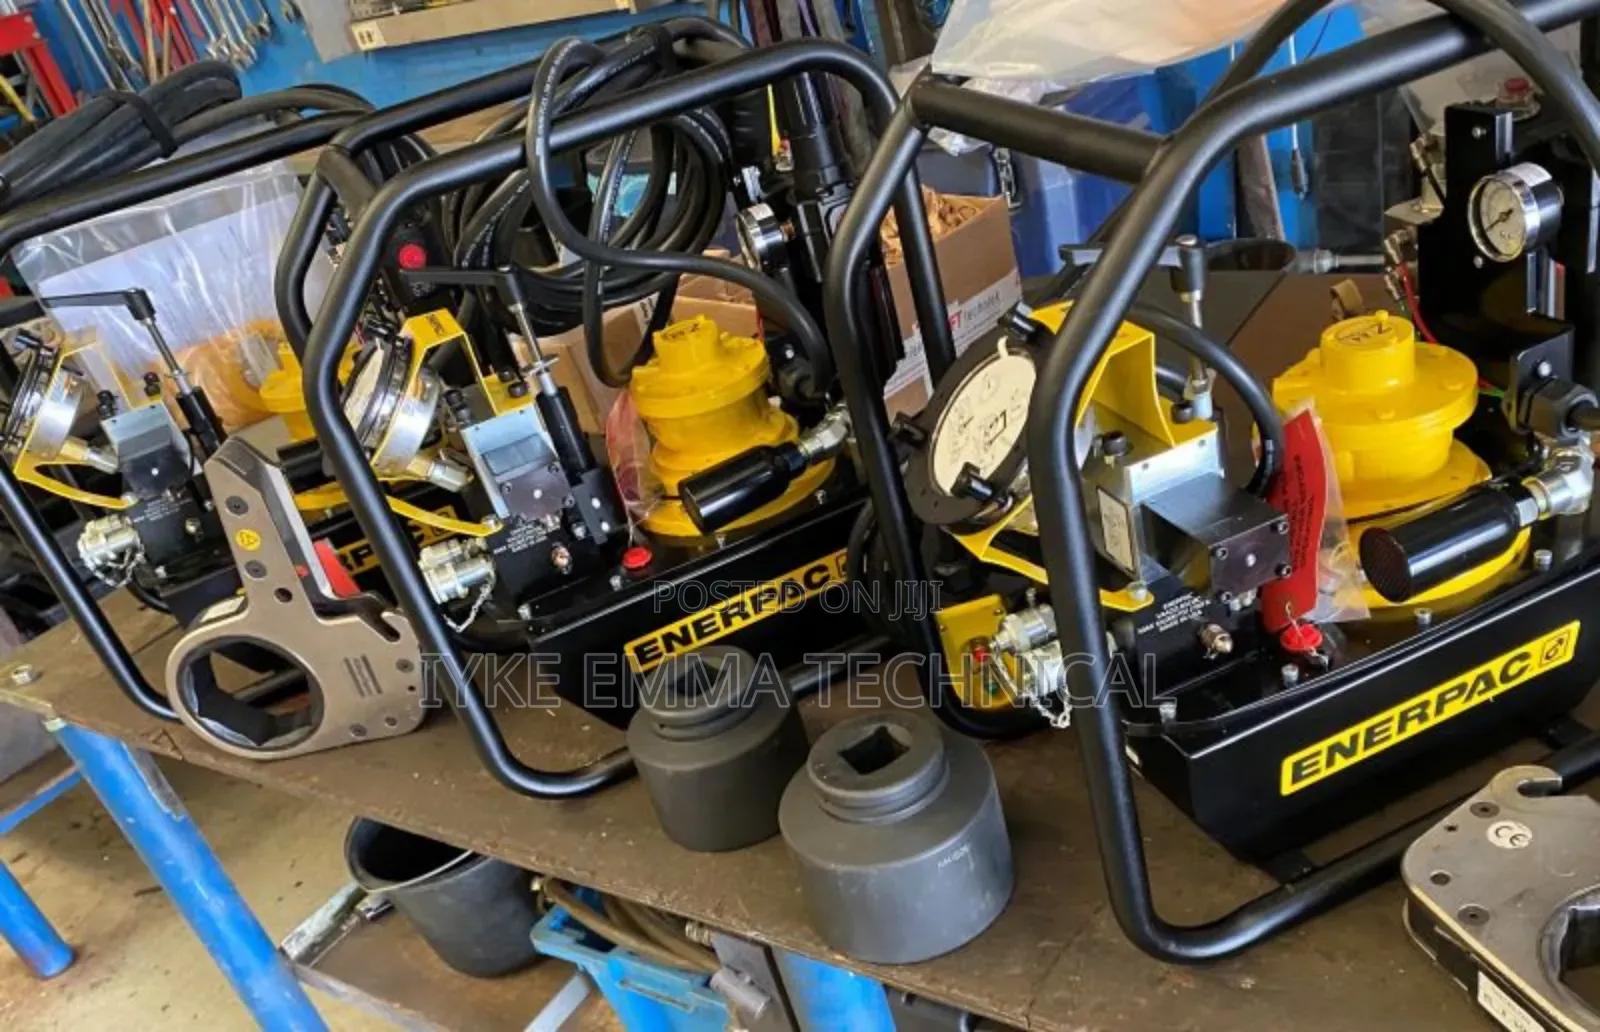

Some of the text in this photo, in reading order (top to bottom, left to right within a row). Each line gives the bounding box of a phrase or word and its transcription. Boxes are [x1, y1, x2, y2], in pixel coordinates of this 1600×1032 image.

[633, 564, 830, 663] ENERPAC
[1291, 651, 1534, 786] ENERPAC
[1494, 825, 1528, 847] CE
